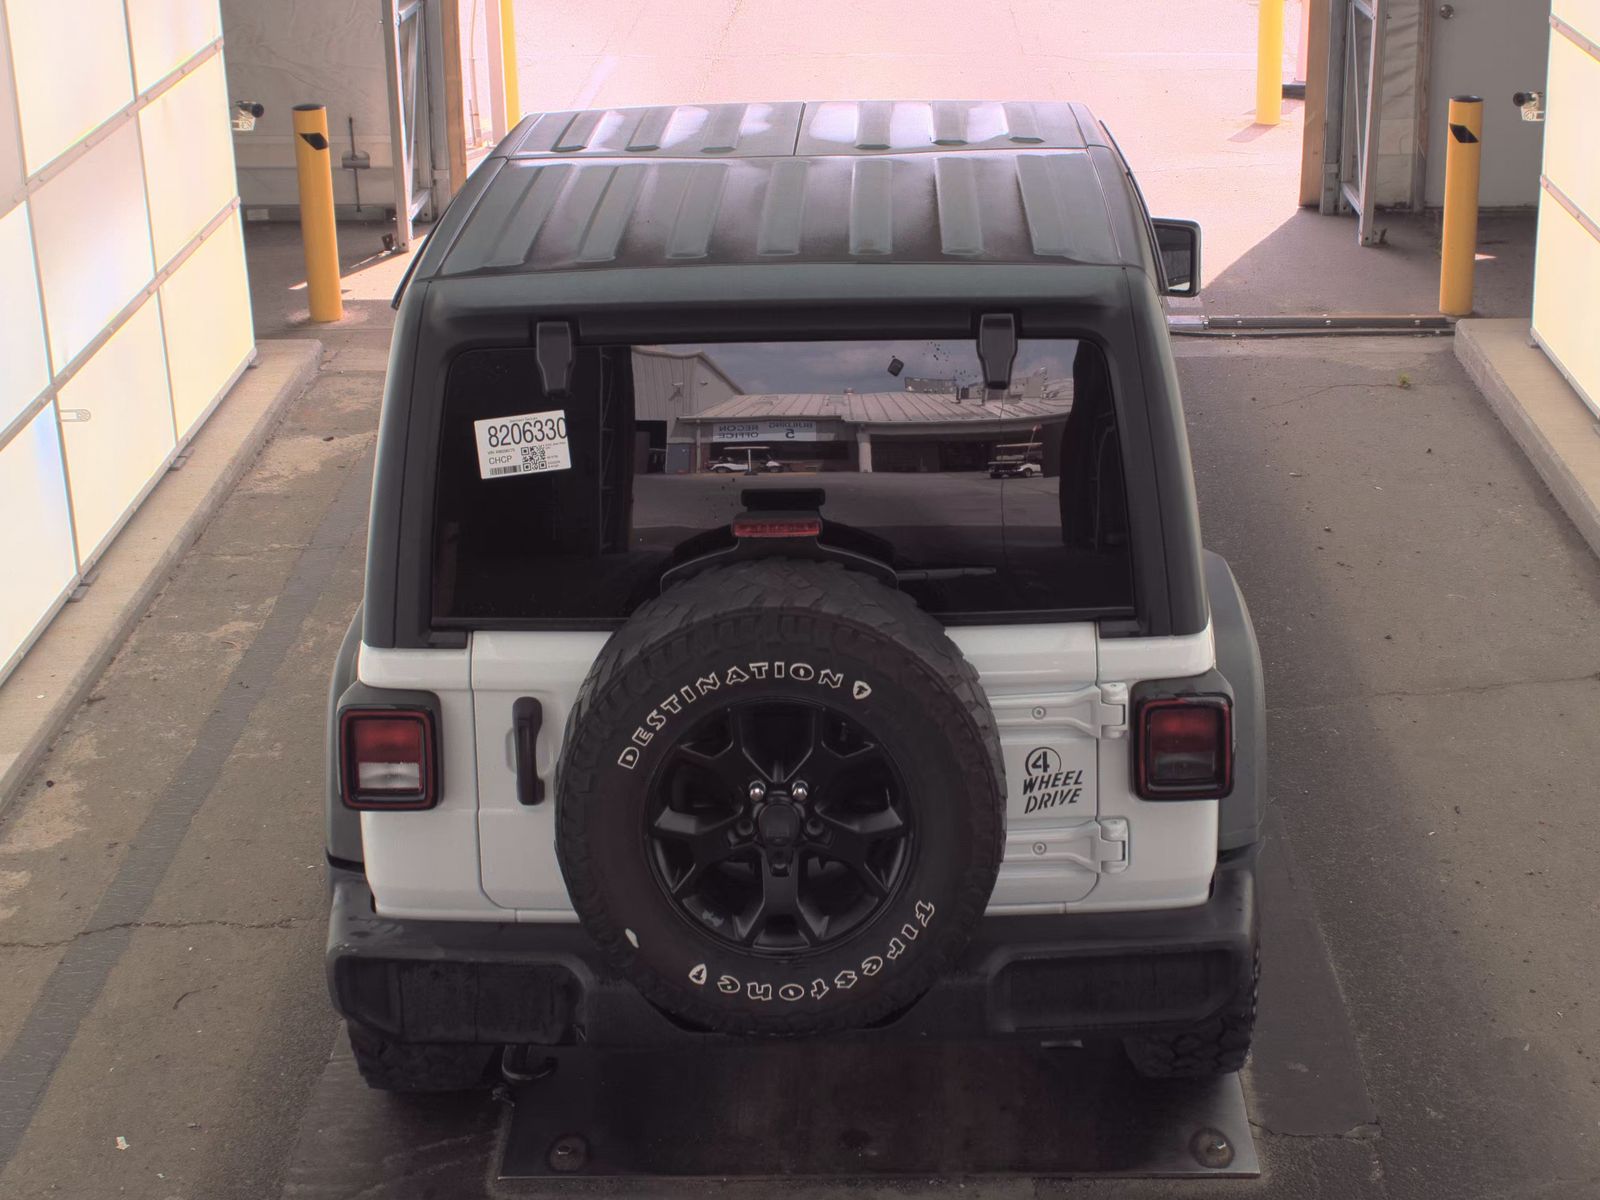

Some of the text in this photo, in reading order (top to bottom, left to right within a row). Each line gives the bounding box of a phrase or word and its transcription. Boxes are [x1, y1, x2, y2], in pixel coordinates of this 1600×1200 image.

[488, 417, 568, 447] 8206330
[489, 455, 512, 465] CHCP
[617, 662, 845, 770] DESTINATION
[1031, 751, 1050, 773] 4
[1023, 770, 1083, 796] WHEEL
[1024, 788, 1082, 814] DRIVE
